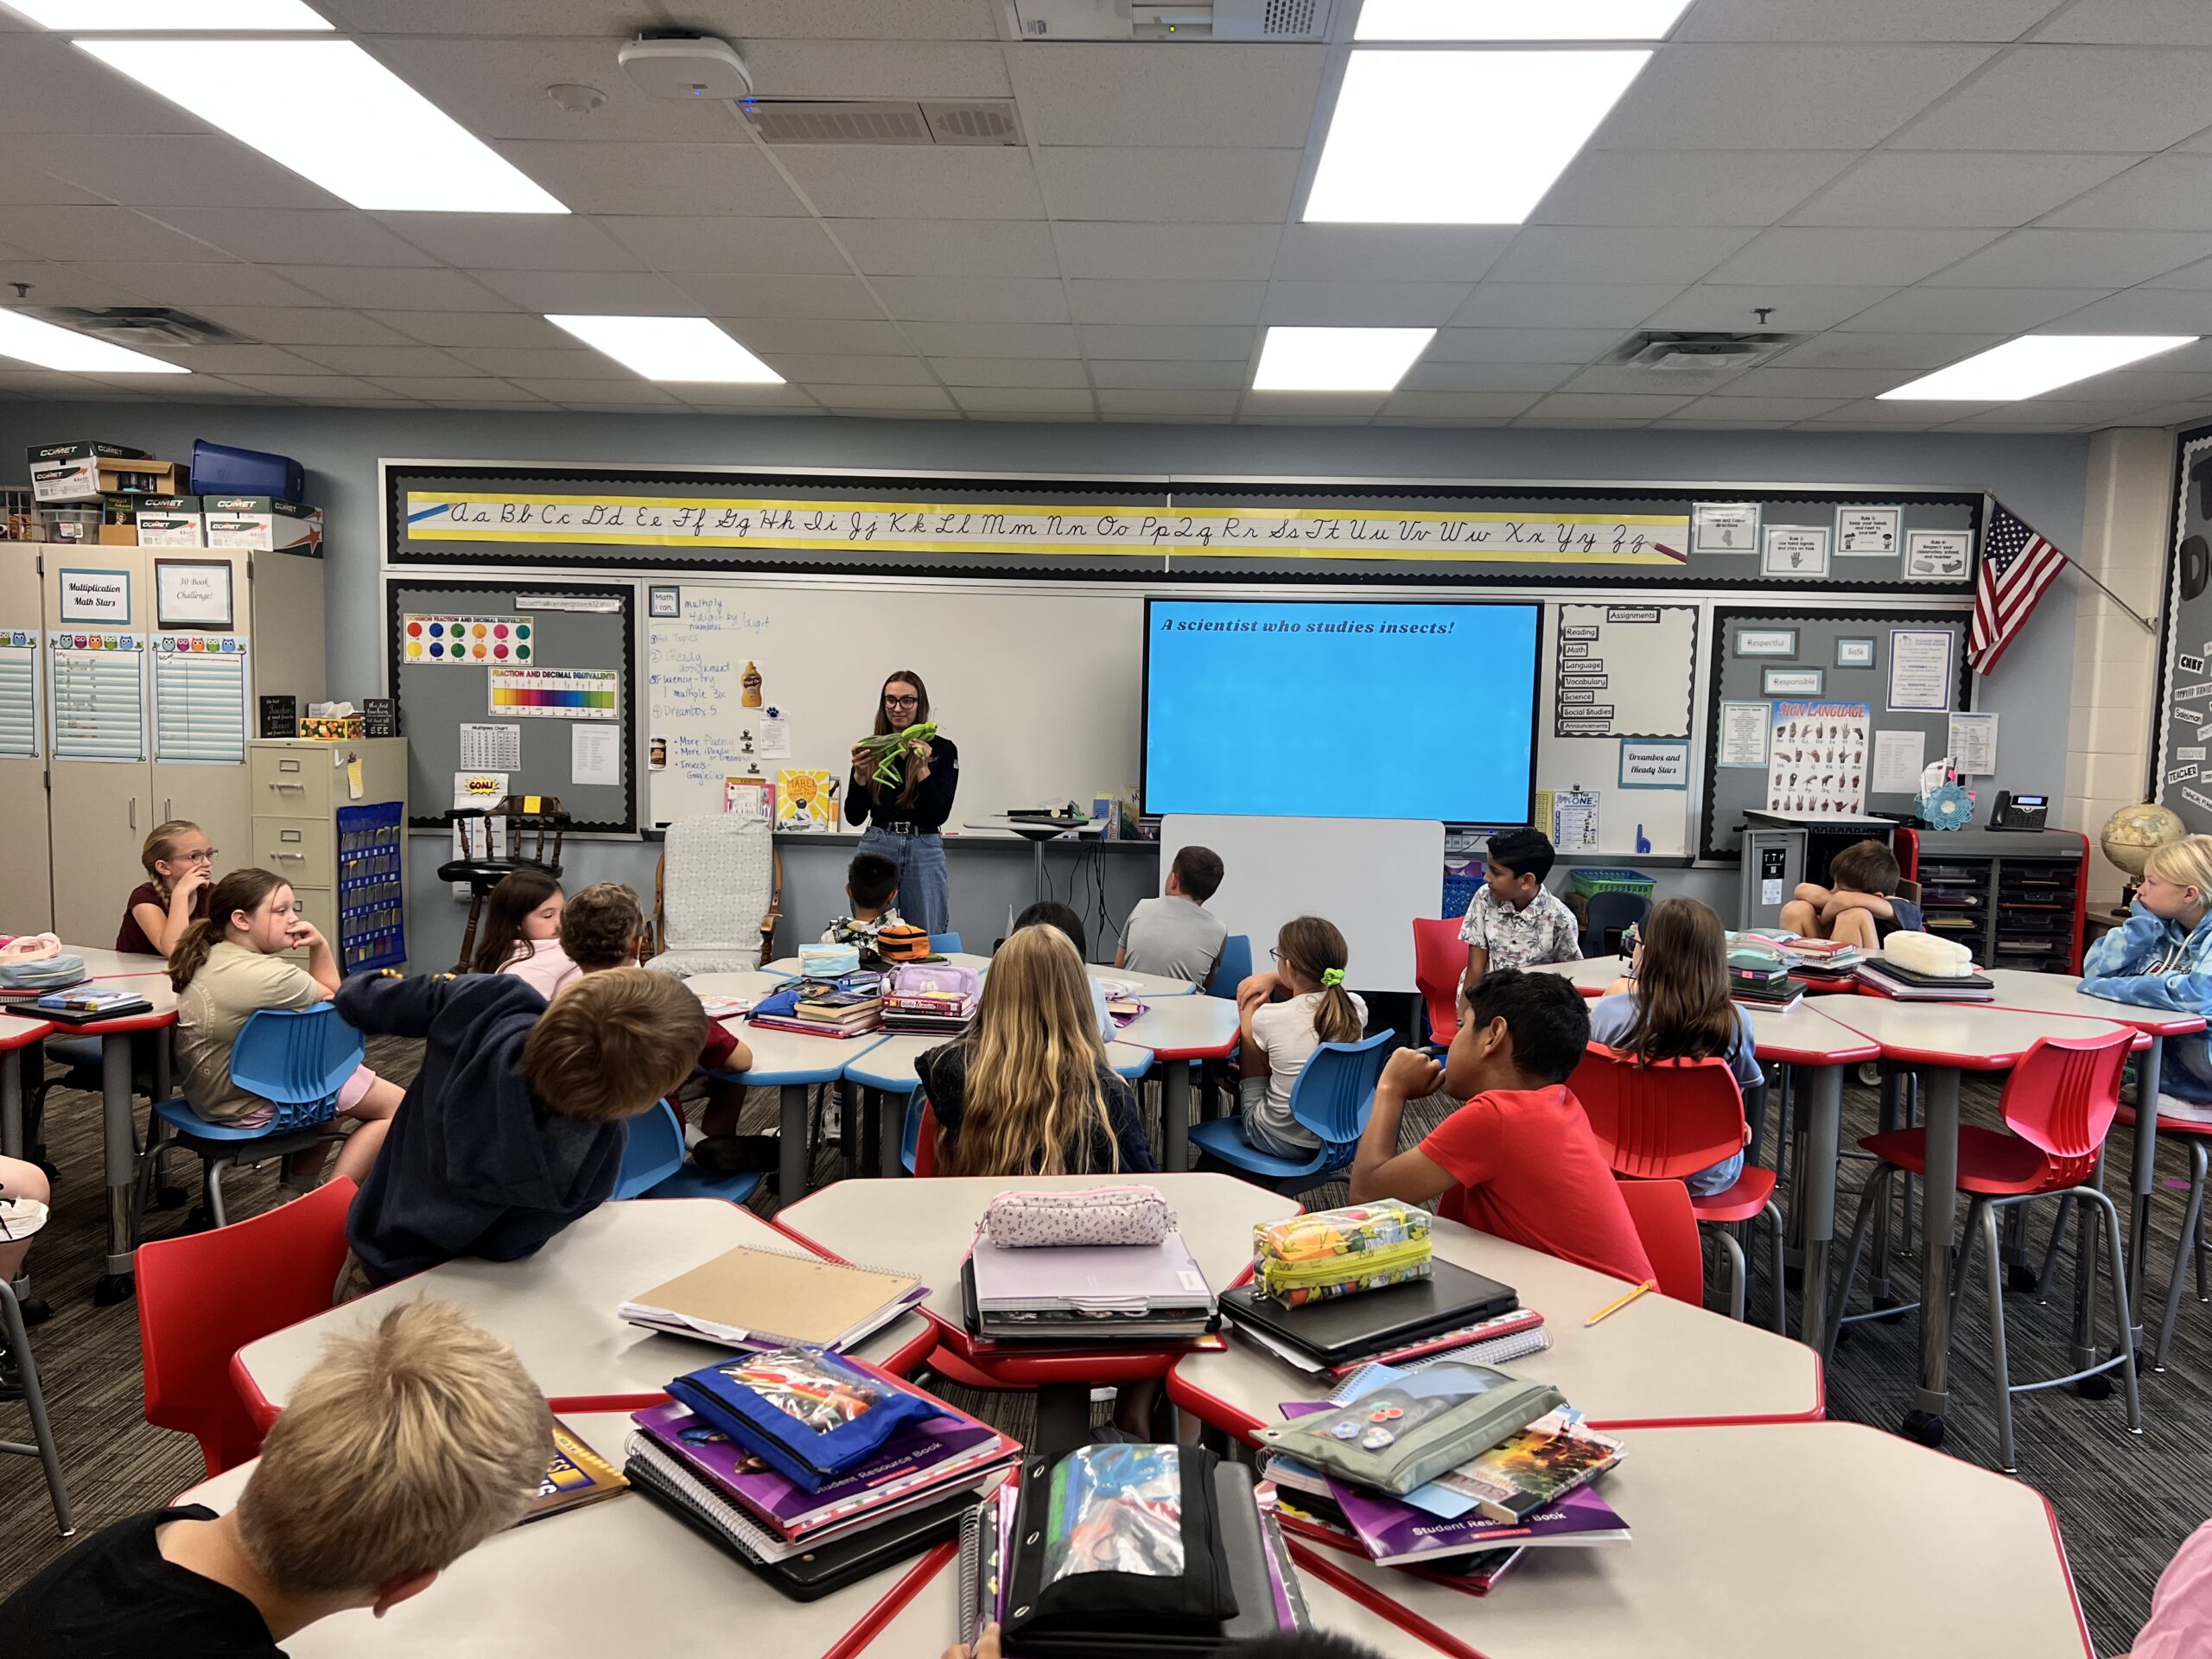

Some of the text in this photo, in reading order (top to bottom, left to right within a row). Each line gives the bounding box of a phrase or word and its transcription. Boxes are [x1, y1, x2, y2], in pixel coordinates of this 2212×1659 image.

[40, 446, 78, 457] COMET
[98, 445, 123, 456] COMET
[36, 471, 63, 481] COMET
[145, 499, 184, 507] COMET
[218, 499, 257, 509] COMET
[275, 502, 296, 512] COMET
[213, 522, 241, 531] COMET
[179, 577, 211, 588] 30 Book
[68, 582, 120, 594] Multiplication
[73, 597, 116, 607] Math Stars
[684, 598, 724, 614] multiply
[727, 612, 738, 626] by
[1610, 610, 1656, 620] Assignments
[1160, 619, 1456, 634] A scientist who studies insects!
[1567, 629, 1596, 638] Reading
[1747, 639, 1784, 648] Respectful
[1565, 661, 1601, 671] Language
[2180, 656, 2203, 672] CHEF
[526, 670, 541, 678] AND
[543, 671, 572, 679] DECIMAL
[573, 671, 615, 680] EQUIVALENTS
[1566, 677, 1605, 686] Vocabulary
[1774, 677, 1815, 687] Responsible
[673, 688, 709, 703] multiple
[1564, 708, 1611, 716] Social Studies
[1779, 702, 1866, 718] SIGN LANGUAGE
[2176, 709, 2202, 722] Salesman
[370, 726, 389, 734] SEE
[679, 736, 699, 747] More
[681, 747, 701, 756] More
[1628, 753, 1681, 762] Dreambox and
[1657, 766, 1676, 775] Stars
[2169, 766, 2197, 782] TEACHER
[787, 779, 817, 789] MABEL
[1572, 797, 1593, 805] ONE
[858, 1455, 913, 1478] Resource
[912, 1442, 944, 1458] Book
[1411, 1522, 1465, 1537] Student
